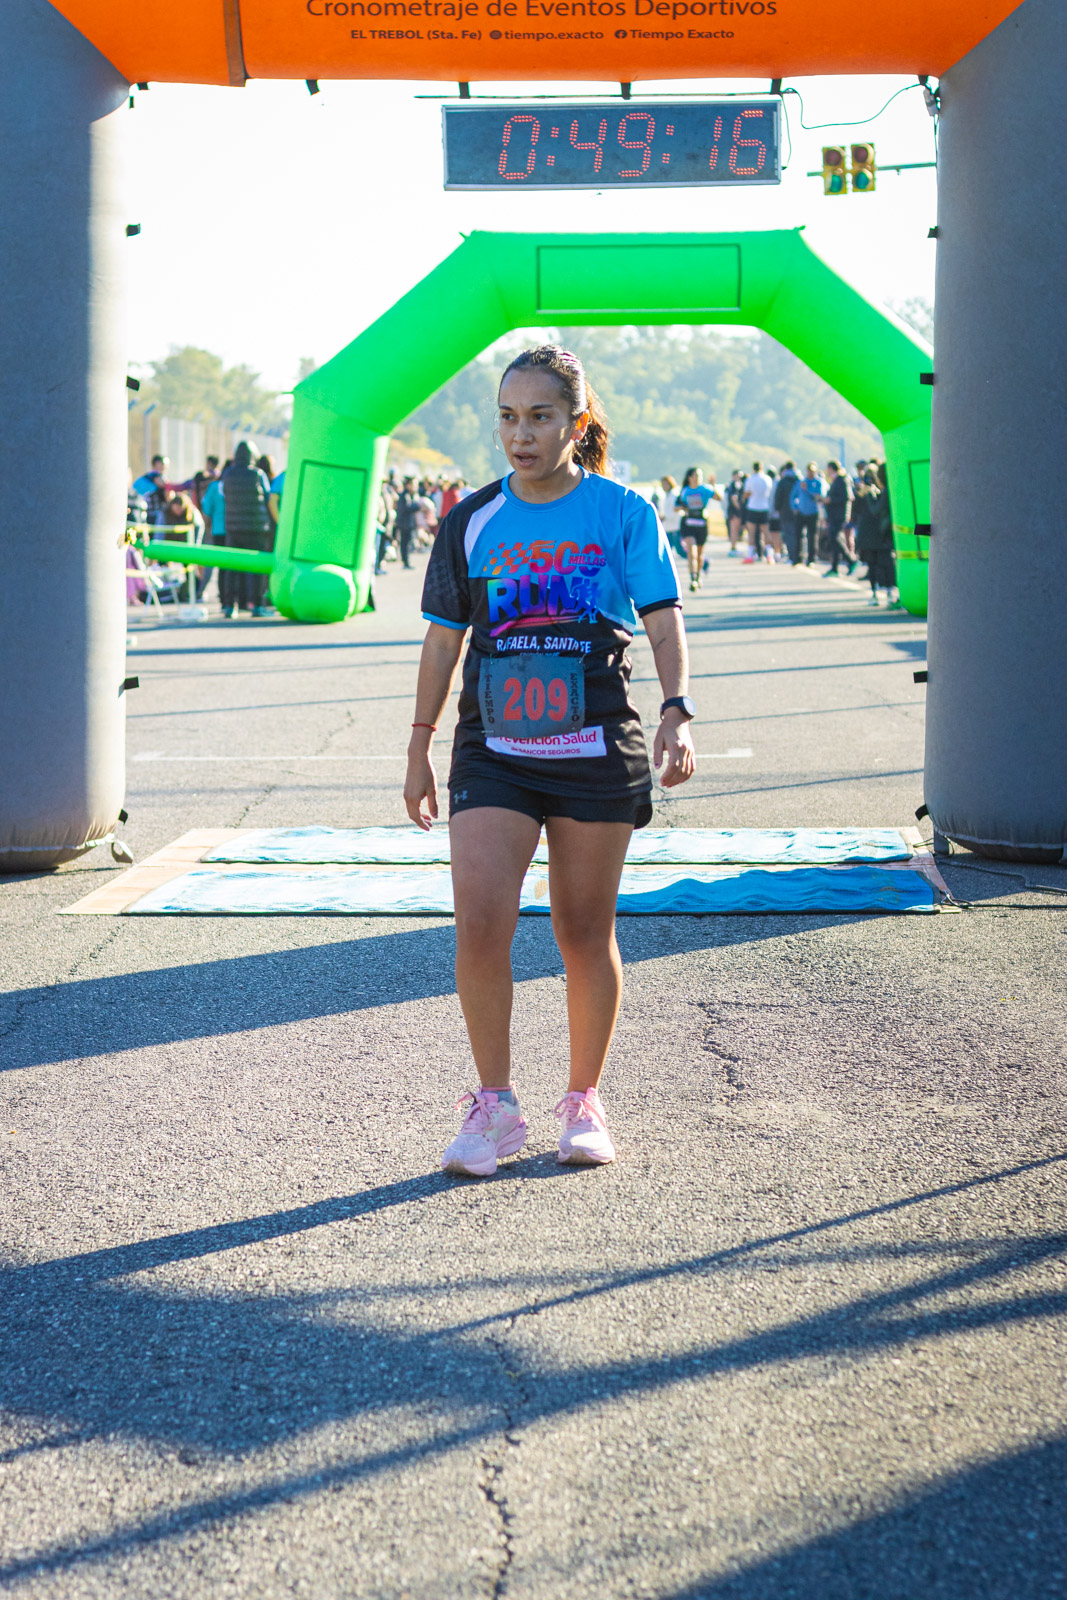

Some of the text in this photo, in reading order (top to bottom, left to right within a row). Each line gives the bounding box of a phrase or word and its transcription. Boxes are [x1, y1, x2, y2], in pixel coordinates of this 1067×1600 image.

[306, 0, 777, 21] Cronometraje de Eventos Deportivos
[351, 29, 482, 40] EL TREBOL (Sta. Fe)
[629, 29, 735, 41] Tiempo Exacto
[568, 555, 607, 567] MILLAS
[487, 575, 587, 623] RUN
[544, 636, 579, 650] SANTA
[484, 674, 495, 724] TIEMPO
[503, 677, 568, 722] 209
[570, 673, 580, 722] EXACTO
[562, 730, 597, 745] Salud
[547, 747, 580, 755] SEGUROS
